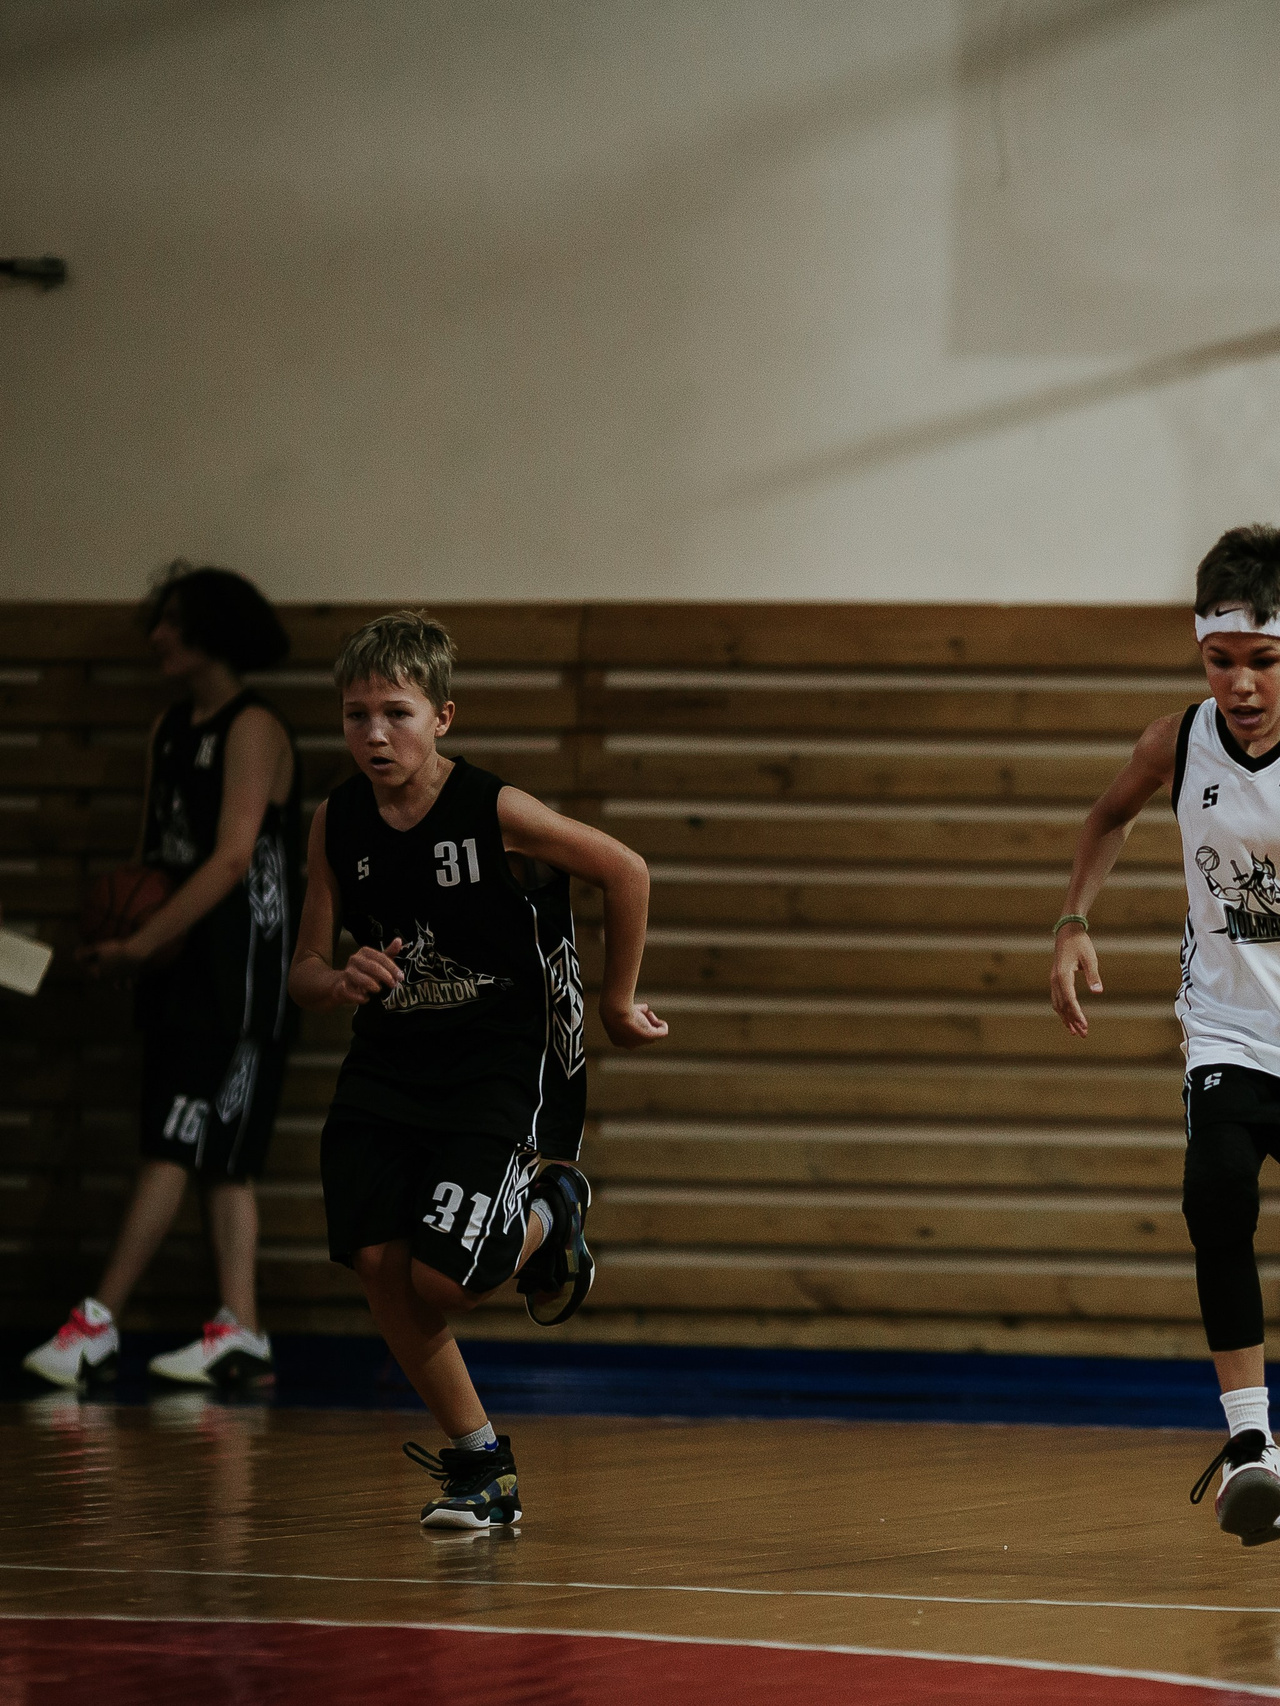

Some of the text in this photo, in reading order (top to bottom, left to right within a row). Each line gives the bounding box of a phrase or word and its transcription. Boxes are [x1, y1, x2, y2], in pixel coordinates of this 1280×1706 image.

[433, 837, 481, 888] 31
[162, 1094, 209, 1145] 16
[422, 1181, 492, 1252] 31
